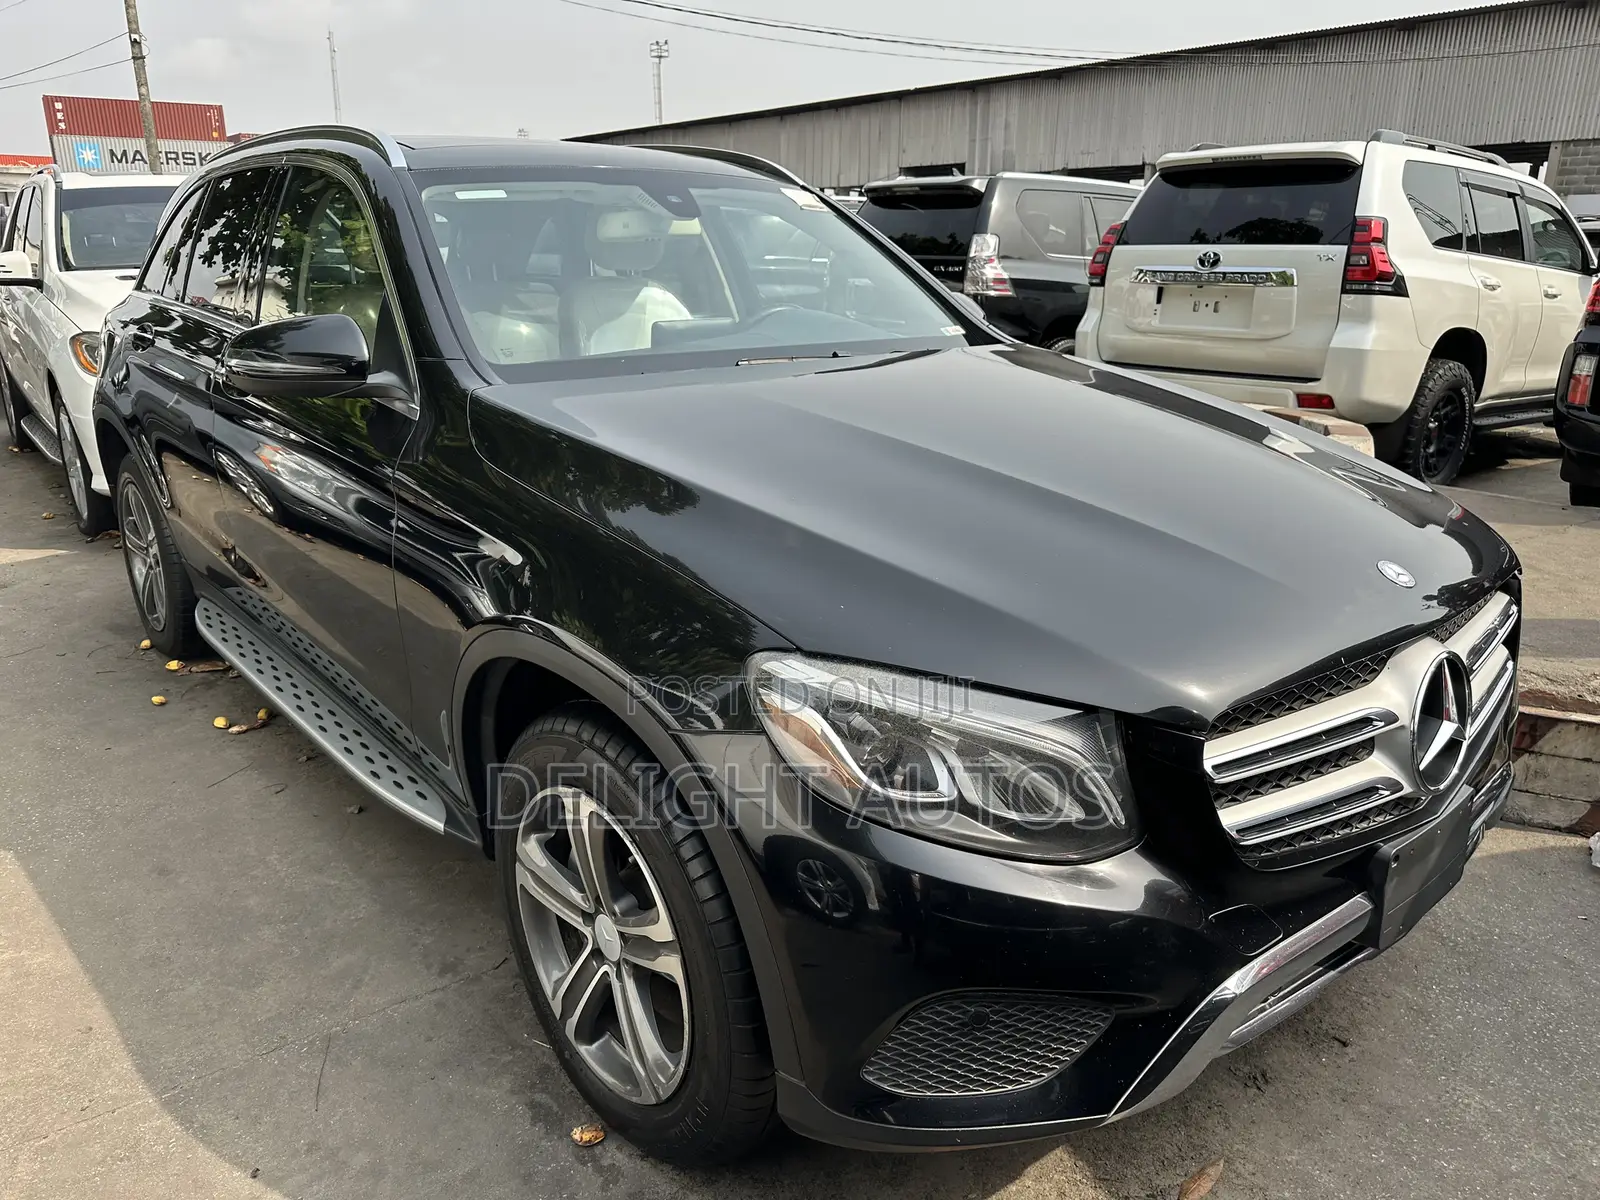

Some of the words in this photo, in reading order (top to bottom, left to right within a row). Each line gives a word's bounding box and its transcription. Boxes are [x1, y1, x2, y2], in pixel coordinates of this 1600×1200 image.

[108, 148, 212, 167] MARSK
[1176, 273, 1223, 282] CRUISER
[1225, 274, 1267, 283] PRADO
